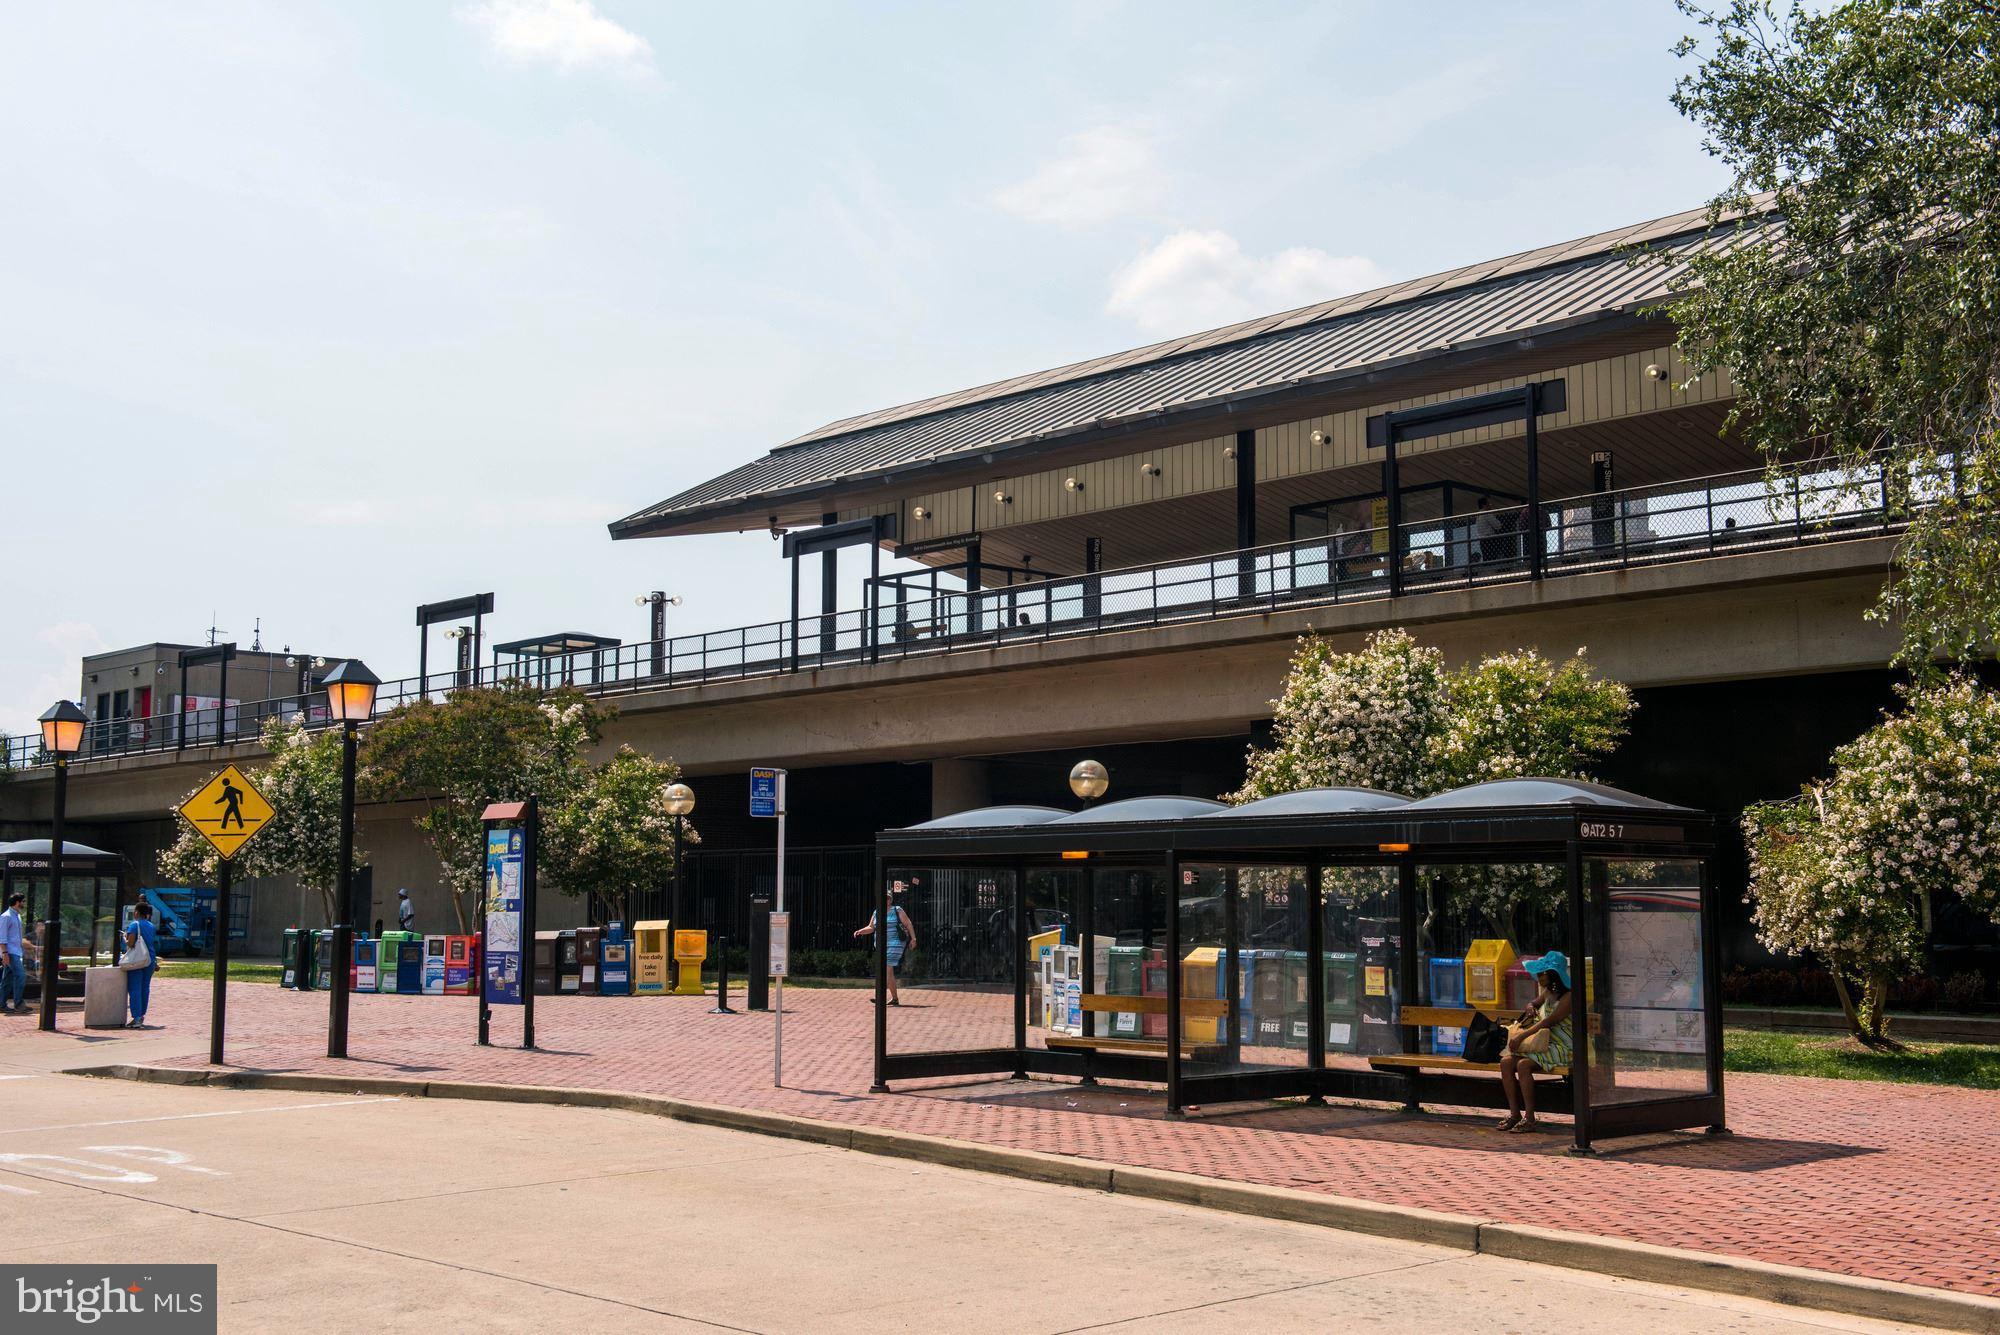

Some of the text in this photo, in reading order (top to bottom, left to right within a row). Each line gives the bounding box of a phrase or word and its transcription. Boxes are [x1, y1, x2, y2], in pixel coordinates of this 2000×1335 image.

[753, 770, 775, 779] DASH
[1590, 824, 1624, 838] AT2 5 7
[489, 844, 508, 854] DASH
[15, 860, 48, 868] 29K 29N
[1260, 1022, 1280, 1033] FREE
